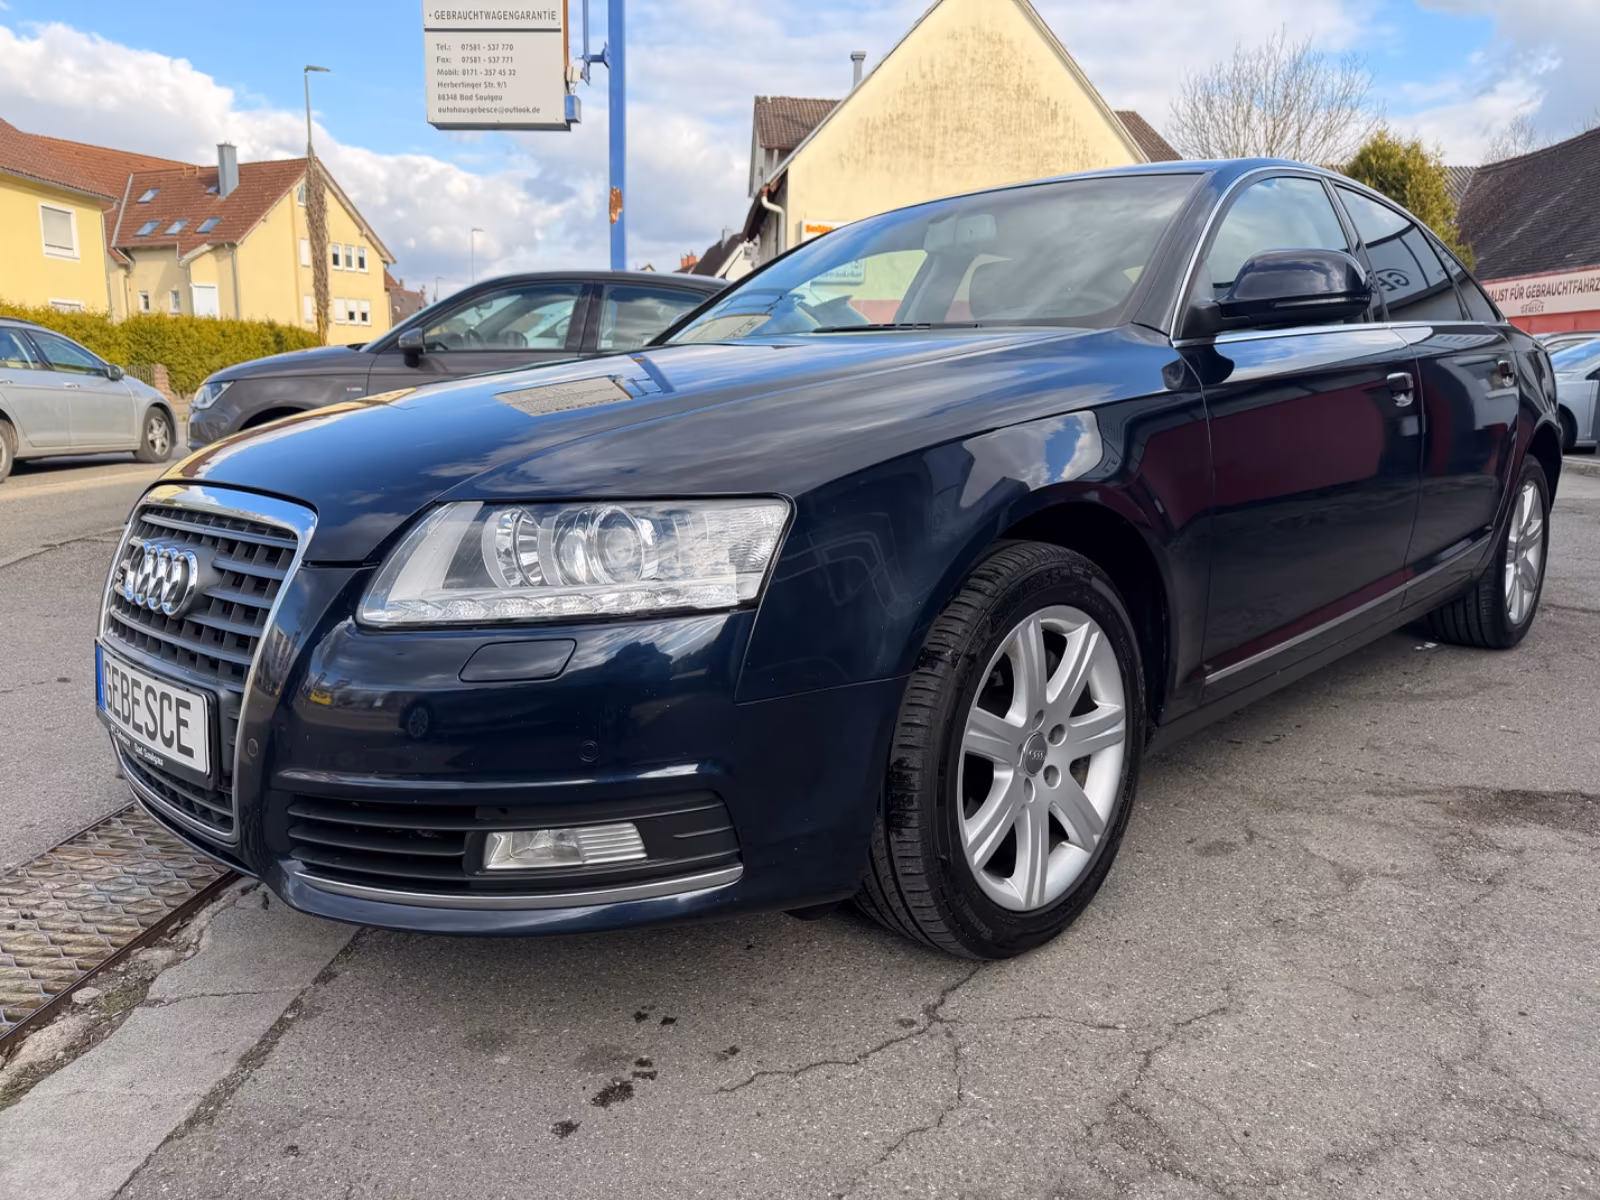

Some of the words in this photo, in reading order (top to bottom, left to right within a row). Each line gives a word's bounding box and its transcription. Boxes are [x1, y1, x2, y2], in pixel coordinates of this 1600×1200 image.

[438, 81, 482, 90] Herbertinger
[475, 94, 502, 102] Saulgau
[438, 106, 540, 114] autohausgebesce@outlook.de
[1510, 284, 1524, 300] FÜR
[104, 660, 194, 758] GEBESCE
